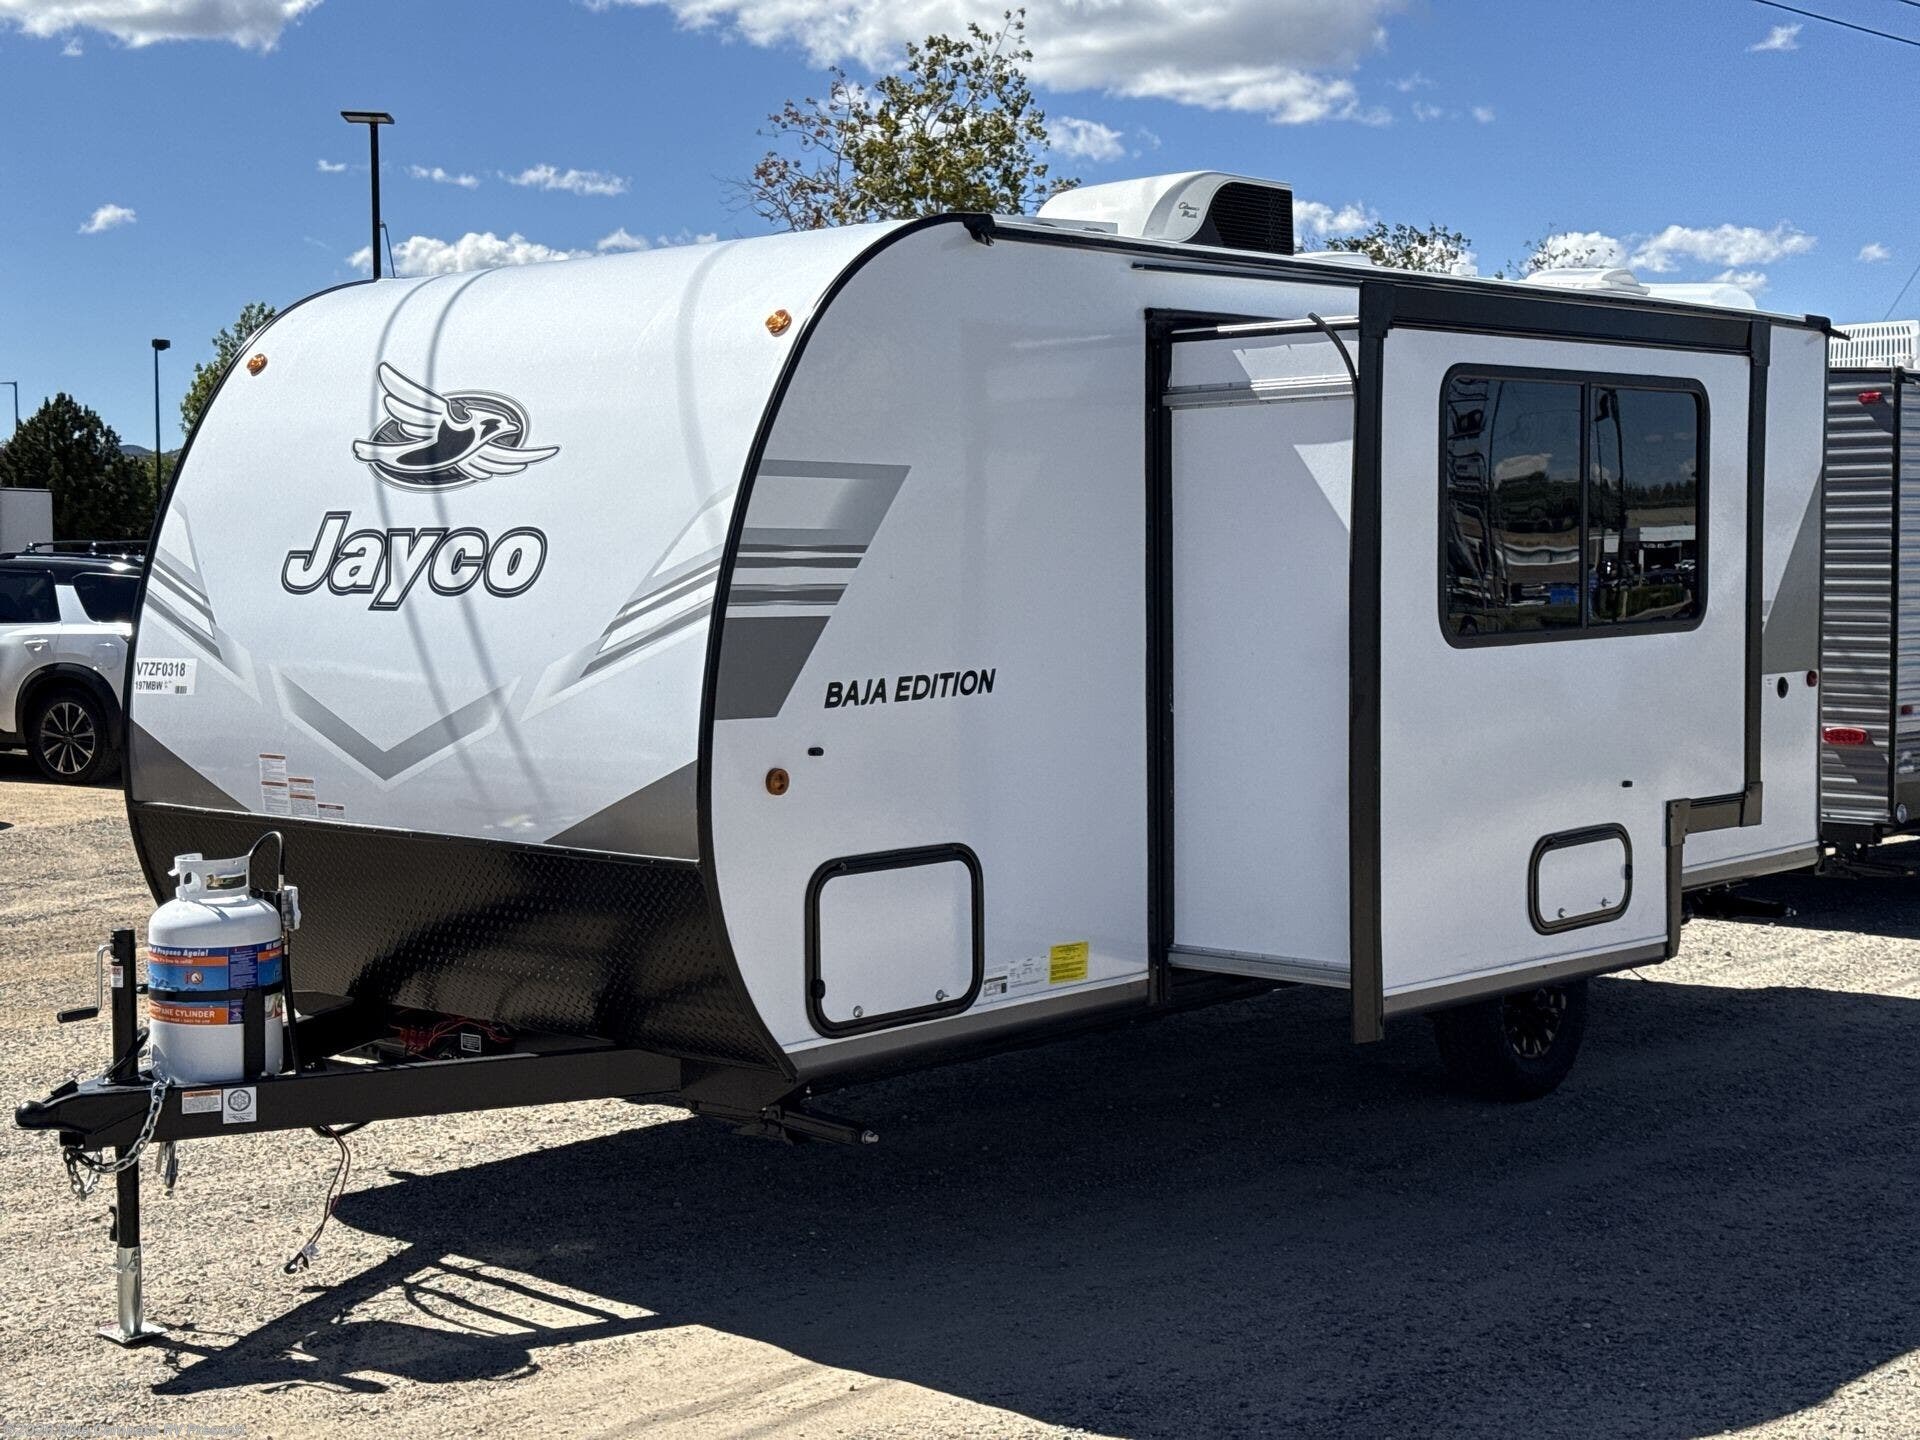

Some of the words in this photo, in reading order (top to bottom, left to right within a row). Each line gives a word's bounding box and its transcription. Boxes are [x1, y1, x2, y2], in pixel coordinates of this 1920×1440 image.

[281, 510, 548, 611] Jayco
[824, 678, 887, 709] BAJA
[894, 668, 996, 703] EDITION
[174, 1010, 216, 1018] CYLINDER
